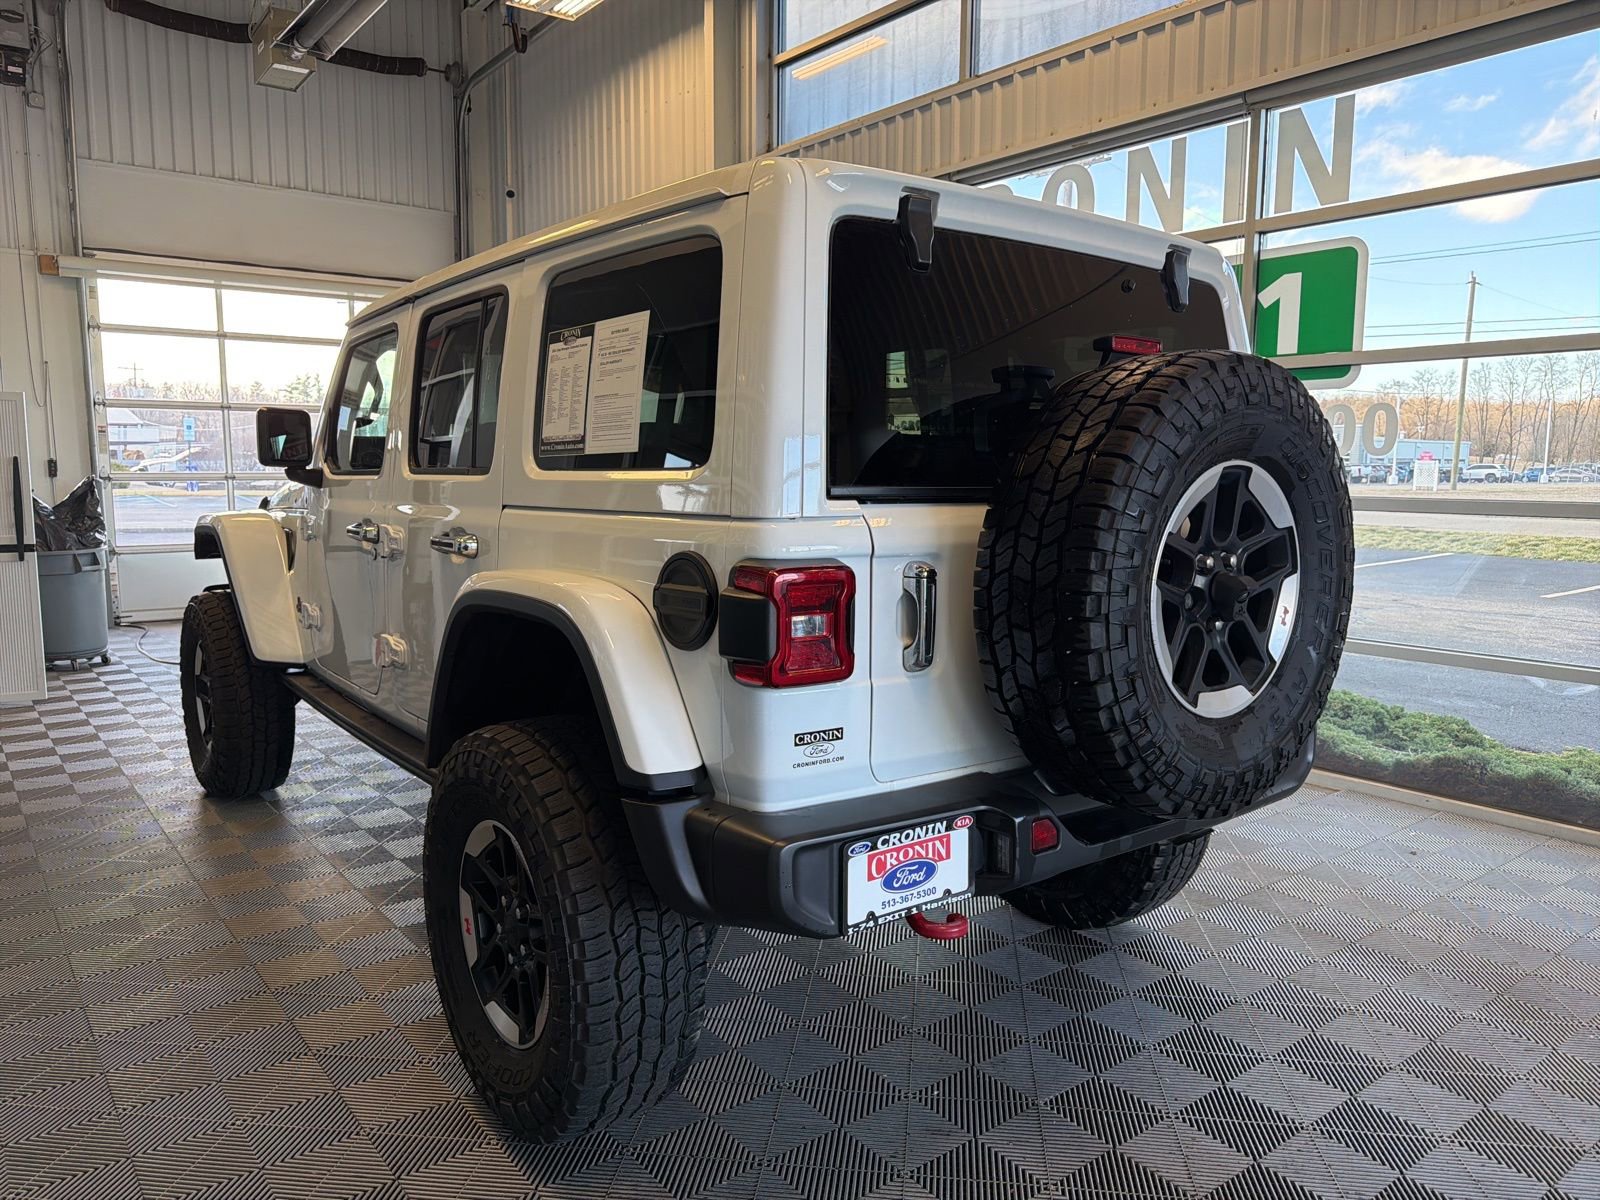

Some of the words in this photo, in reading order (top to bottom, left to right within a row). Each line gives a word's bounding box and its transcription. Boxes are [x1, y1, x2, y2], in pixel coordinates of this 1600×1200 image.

[986, 93, 1356, 233] ONIN
[1257, 272, 1303, 355] 1
[795, 729, 842, 745] CRONIN
[809, 744, 829, 756] Ford
[792, 755, 845, 769] CRONINFORD.COM
[876, 820, 947, 849] CRONIN
[956, 817, 971, 827] KIA
[871, 837, 948, 878] CRONIN
[892, 863, 926, 888] Ford
[881, 886, 937, 910] 513-367-5300
[848, 920, 875, 935] I-74
[878, 910, 908, 925] EXIT
[910, 906, 918, 914] 1
[922, 893, 971, 911] Harrison
